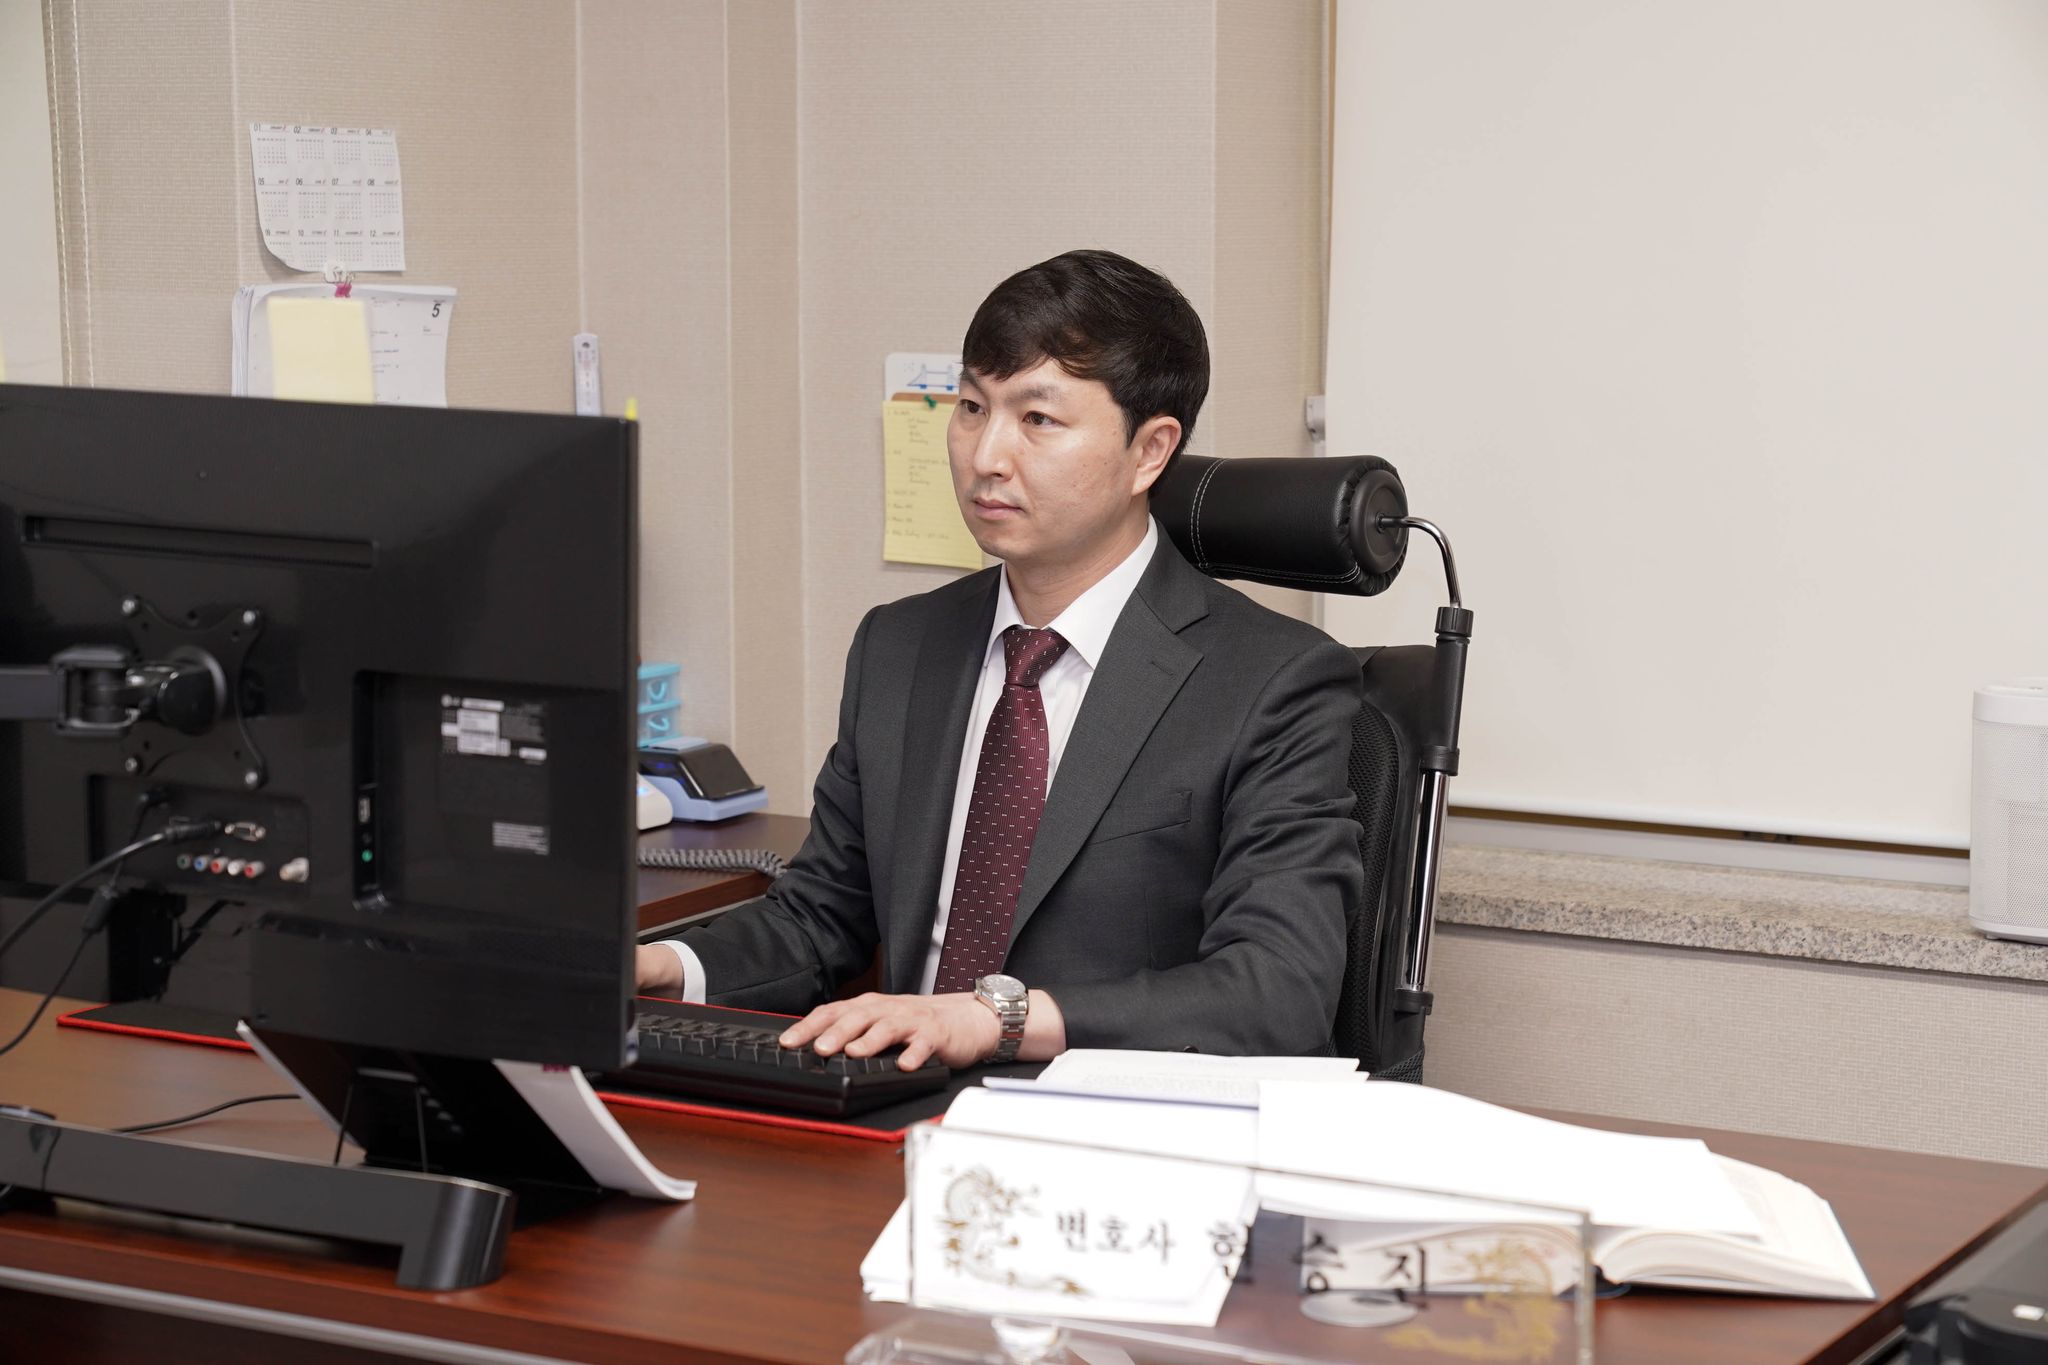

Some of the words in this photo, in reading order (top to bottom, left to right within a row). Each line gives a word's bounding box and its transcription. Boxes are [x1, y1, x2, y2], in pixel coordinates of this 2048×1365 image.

[253, 123, 261, 132] 01
[293, 126, 302, 134] 02
[258, 177, 265, 186] 05
[295, 178, 303, 186] 06
[331, 178, 339, 186] 07
[370, 229, 377, 237] 12
[432, 303, 441, 318] 5
[1057, 1208, 1174, 1264] 변호사
[1292, 1230, 1344, 1294] 승
[1382, 1244, 1430, 1310] 진
